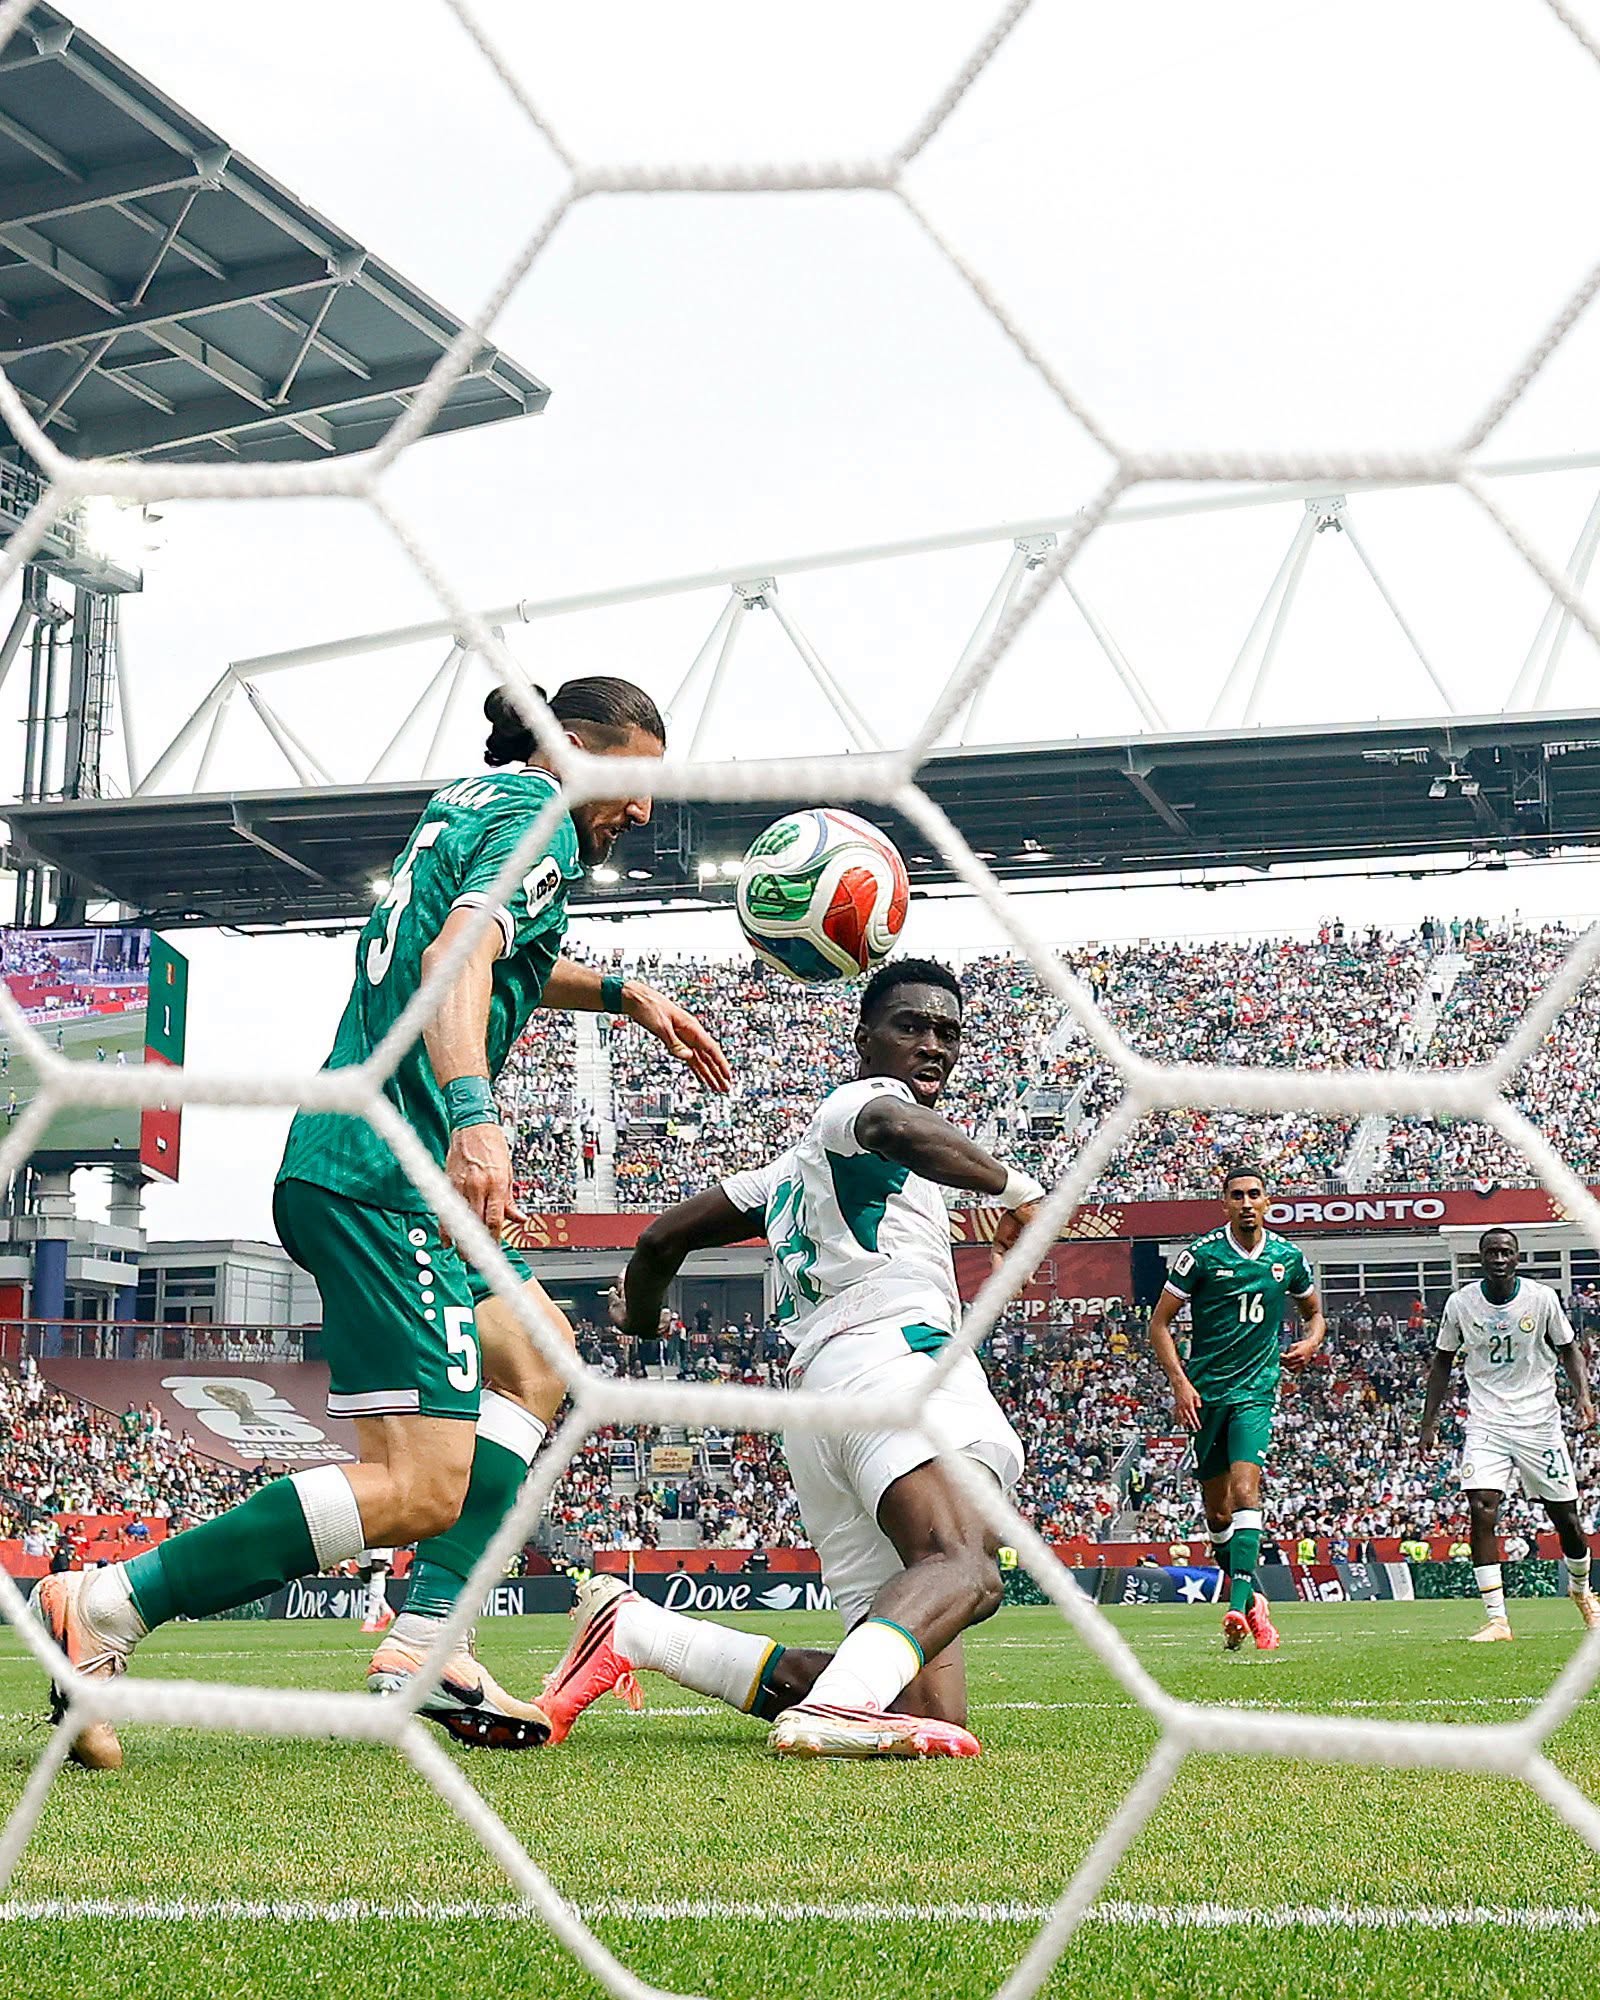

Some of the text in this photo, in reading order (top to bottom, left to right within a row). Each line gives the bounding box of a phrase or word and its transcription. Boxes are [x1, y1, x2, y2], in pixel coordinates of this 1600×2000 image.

[366, 820, 449, 986] 5
[1263, 1198, 1445, 1225] ORONTO
[1237, 1293, 1264, 1323] 16
[443, 1306, 478, 1392] 5
[1489, 1334, 1515, 1364] 21
[242, 1427, 297, 1438] FIFA
[1542, 1449, 1569, 1479] 21
[285, 1578, 328, 1619] Dove
[350, 1588, 370, 1619] ME
[664, 1573, 750, 1611] Dove
[1119, 1574, 1140, 1606] ove
